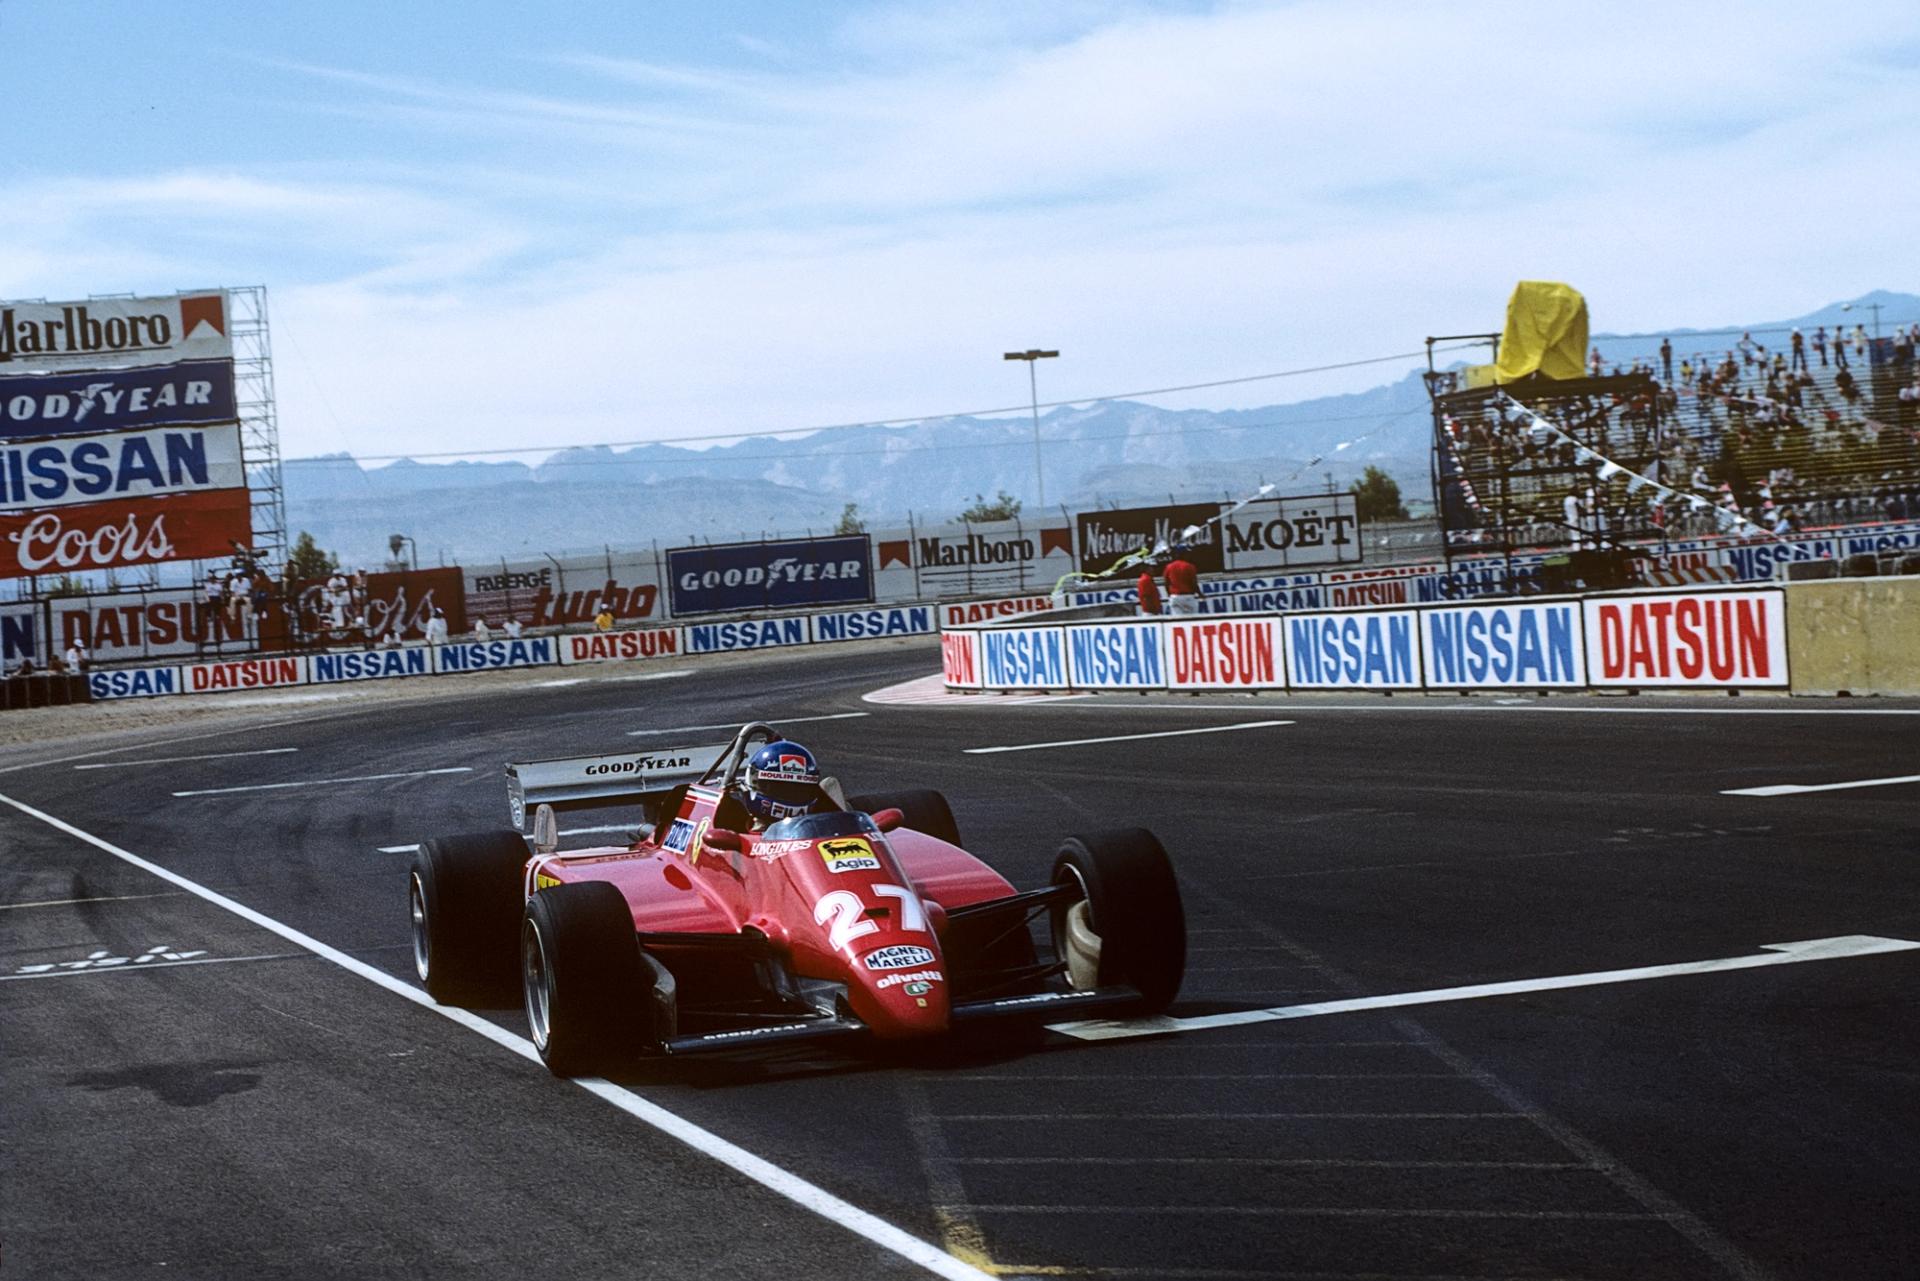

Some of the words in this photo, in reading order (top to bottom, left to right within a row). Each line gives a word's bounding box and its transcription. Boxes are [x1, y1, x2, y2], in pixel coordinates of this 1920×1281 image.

[0, 381, 213, 421] ODYEAR
[9, 513, 176, 571] Coors
[1226, 510, 1355, 553] MOËT
[919, 534, 1034, 567] Marlboro
[680, 559, 861, 591] GOODYEAR
[692, 618, 803, 651] NISSAN
[819, 607, 929, 641] NISSAN
[1600, 598, 1771, 681] DATSUN
[442, 638, 550, 671] NISSAN
[572, 630, 677, 660] DATSUN
[986, 631, 1062, 684] NISSAN
[1072, 626, 1161, 685] NISSAN
[1172, 622, 1274, 683] DATSUN
[1292, 615, 1413, 684] NISSAN
[1430, 607, 1577, 684] NISSAN
[193, 658, 298, 690] DATSUN
[316, 648, 425, 681] NISSAN
[91, 668, 173, 698] SSAN
[585, 757, 691, 776] GOODYEAR
[750, 840, 813, 856] LONGINES
[835, 858, 875, 870] Agip
[814, 884, 926, 951] 27
[876, 970, 943, 989] olivetti
